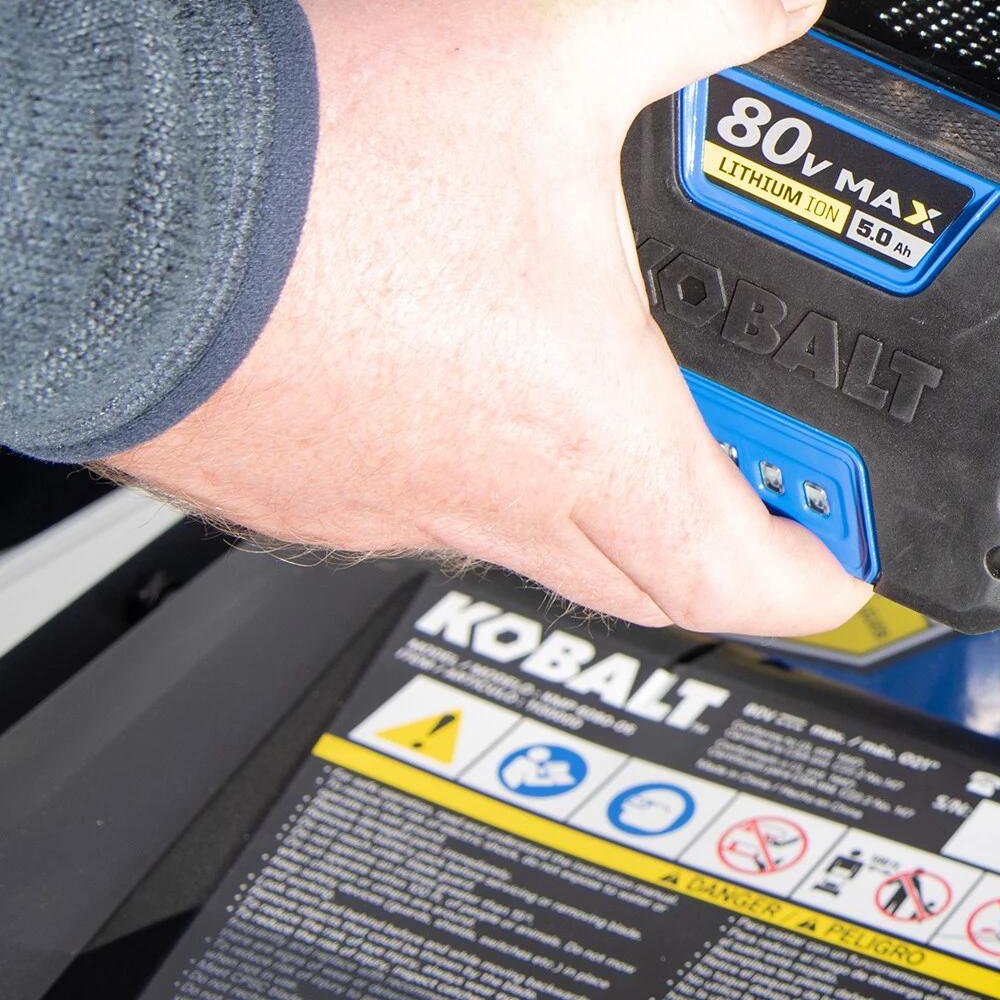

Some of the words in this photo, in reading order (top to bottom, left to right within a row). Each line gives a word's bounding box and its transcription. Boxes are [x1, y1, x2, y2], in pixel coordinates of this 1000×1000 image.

[718, 156, 803, 206] LITHIUM
[804, 196, 840, 223] ION
[856, 217, 893, 247] 5.0
[893, 242, 911, 258] Ah
[835, 167, 942, 233] MAX
[415, 591, 730, 730] KOBALT
[686, 876, 781, 918] DANGER
[825, 923, 926, 966] PELIGRO
